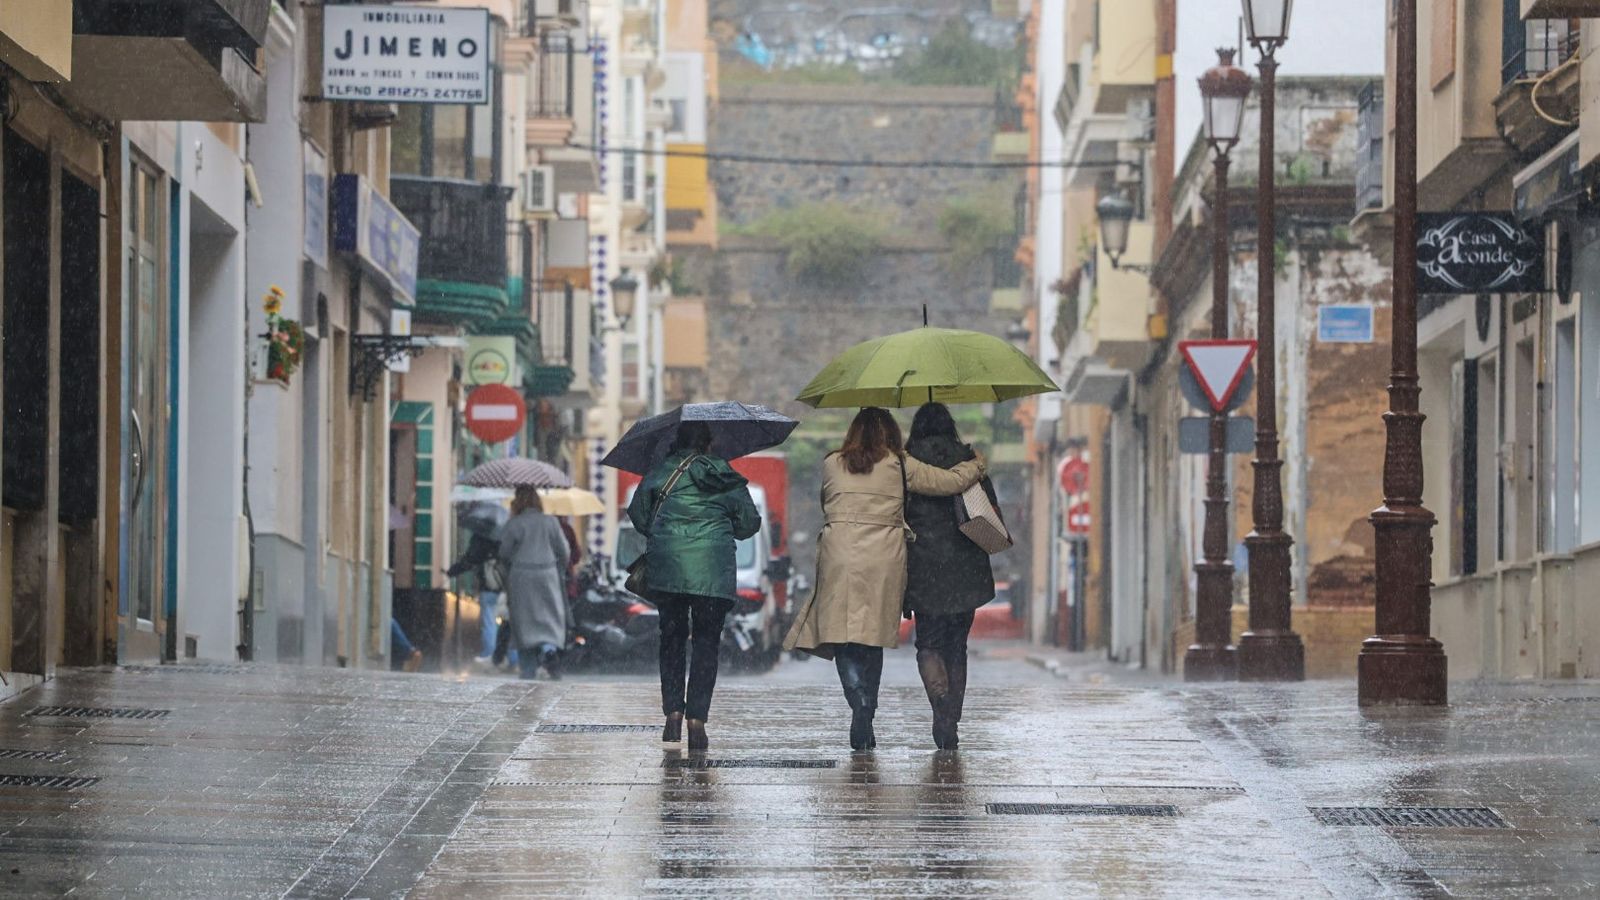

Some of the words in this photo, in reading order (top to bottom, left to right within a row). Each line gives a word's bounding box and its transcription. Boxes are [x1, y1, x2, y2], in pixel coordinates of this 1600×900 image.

[363, 12, 445, 24] INMOBILIARIA
[334, 29, 478, 60] JIMENO
[411, 70, 416, 79] Y
[425, 70, 480, 81] COMUNDADES
[328, 85, 371, 96] TLFNO
[1458, 230, 1497, 245] Casa
